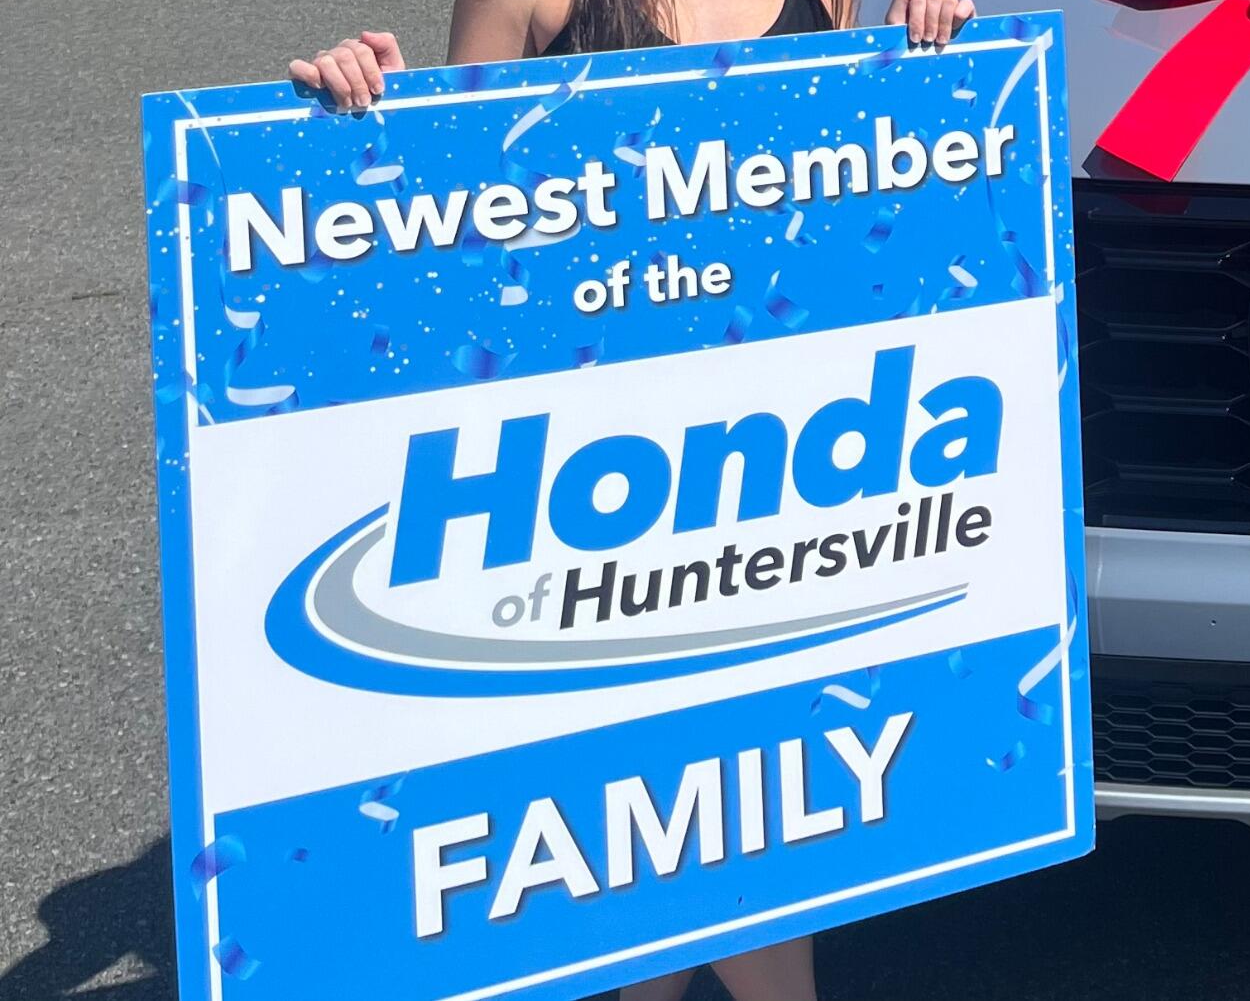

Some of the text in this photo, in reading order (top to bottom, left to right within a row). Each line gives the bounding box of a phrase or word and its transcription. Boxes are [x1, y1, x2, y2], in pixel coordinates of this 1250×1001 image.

[226, 116, 1015, 271] Newest Member
[573, 255, 732, 312] of the
[390, 345, 1004, 587] Honda
[491, 493, 993, 630] of Huntersville
[411, 712, 914, 939] FAMILY
